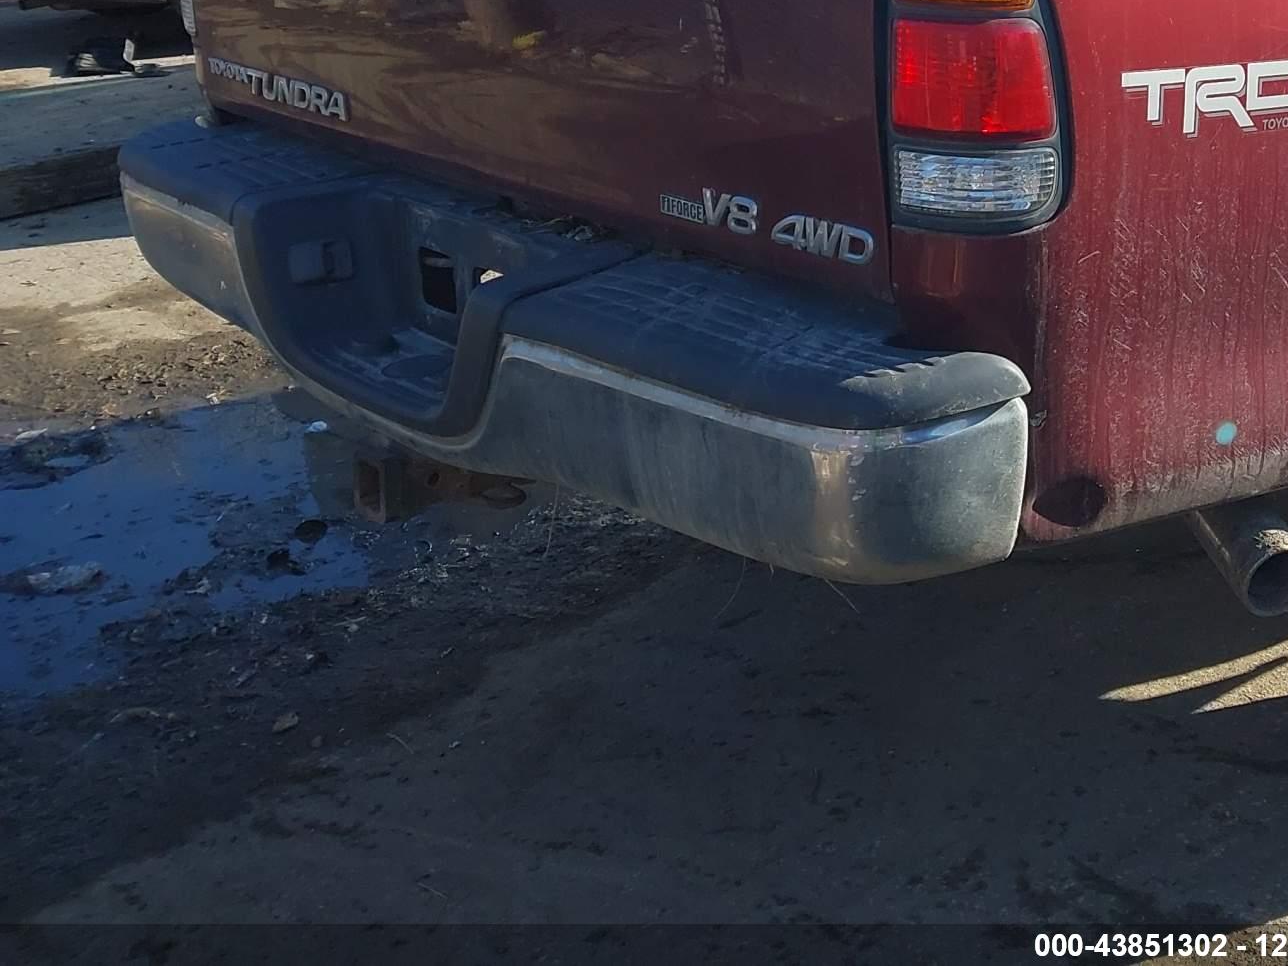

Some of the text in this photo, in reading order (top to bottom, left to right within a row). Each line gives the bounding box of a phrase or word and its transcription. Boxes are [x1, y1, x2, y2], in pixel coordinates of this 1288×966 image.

[208, 57, 347, 122] TOYOTA TUNDRA
[702, 187, 759, 234] V8
[771, 214, 874, 265] 4WD
